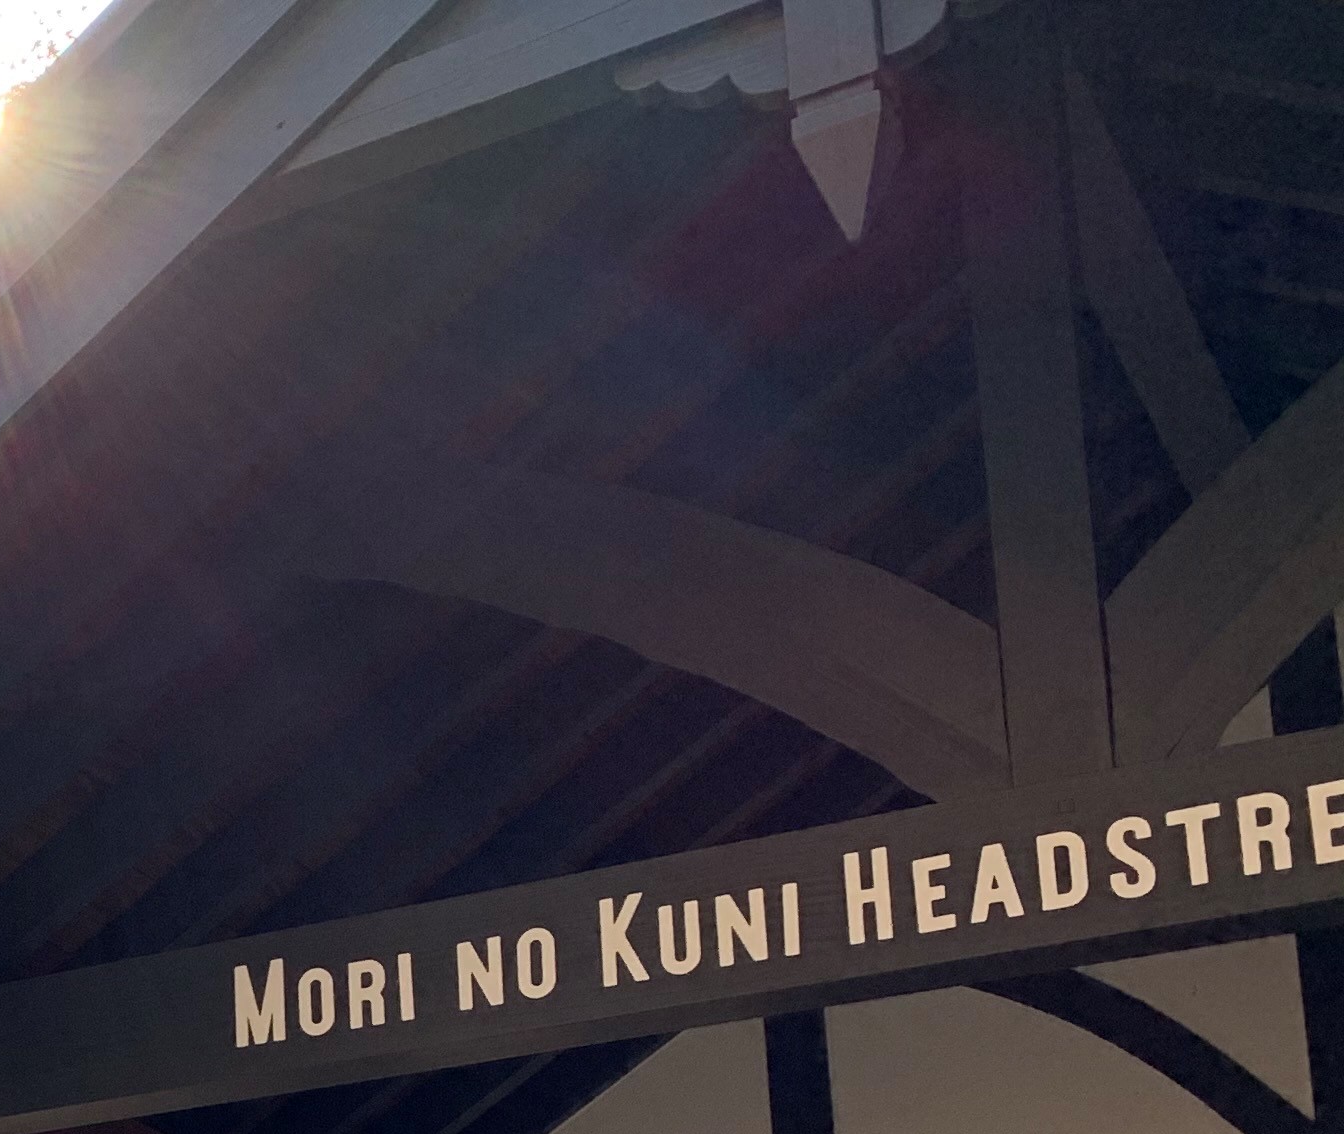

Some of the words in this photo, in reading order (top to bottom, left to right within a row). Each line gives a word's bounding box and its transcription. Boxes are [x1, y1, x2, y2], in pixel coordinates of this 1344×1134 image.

[233, 952, 415, 1048] MORI
[456, 927, 557, 1011] NO
[598, 882, 801, 988] KUNI
[842, 779, 1344, 946] HEADSTRE
